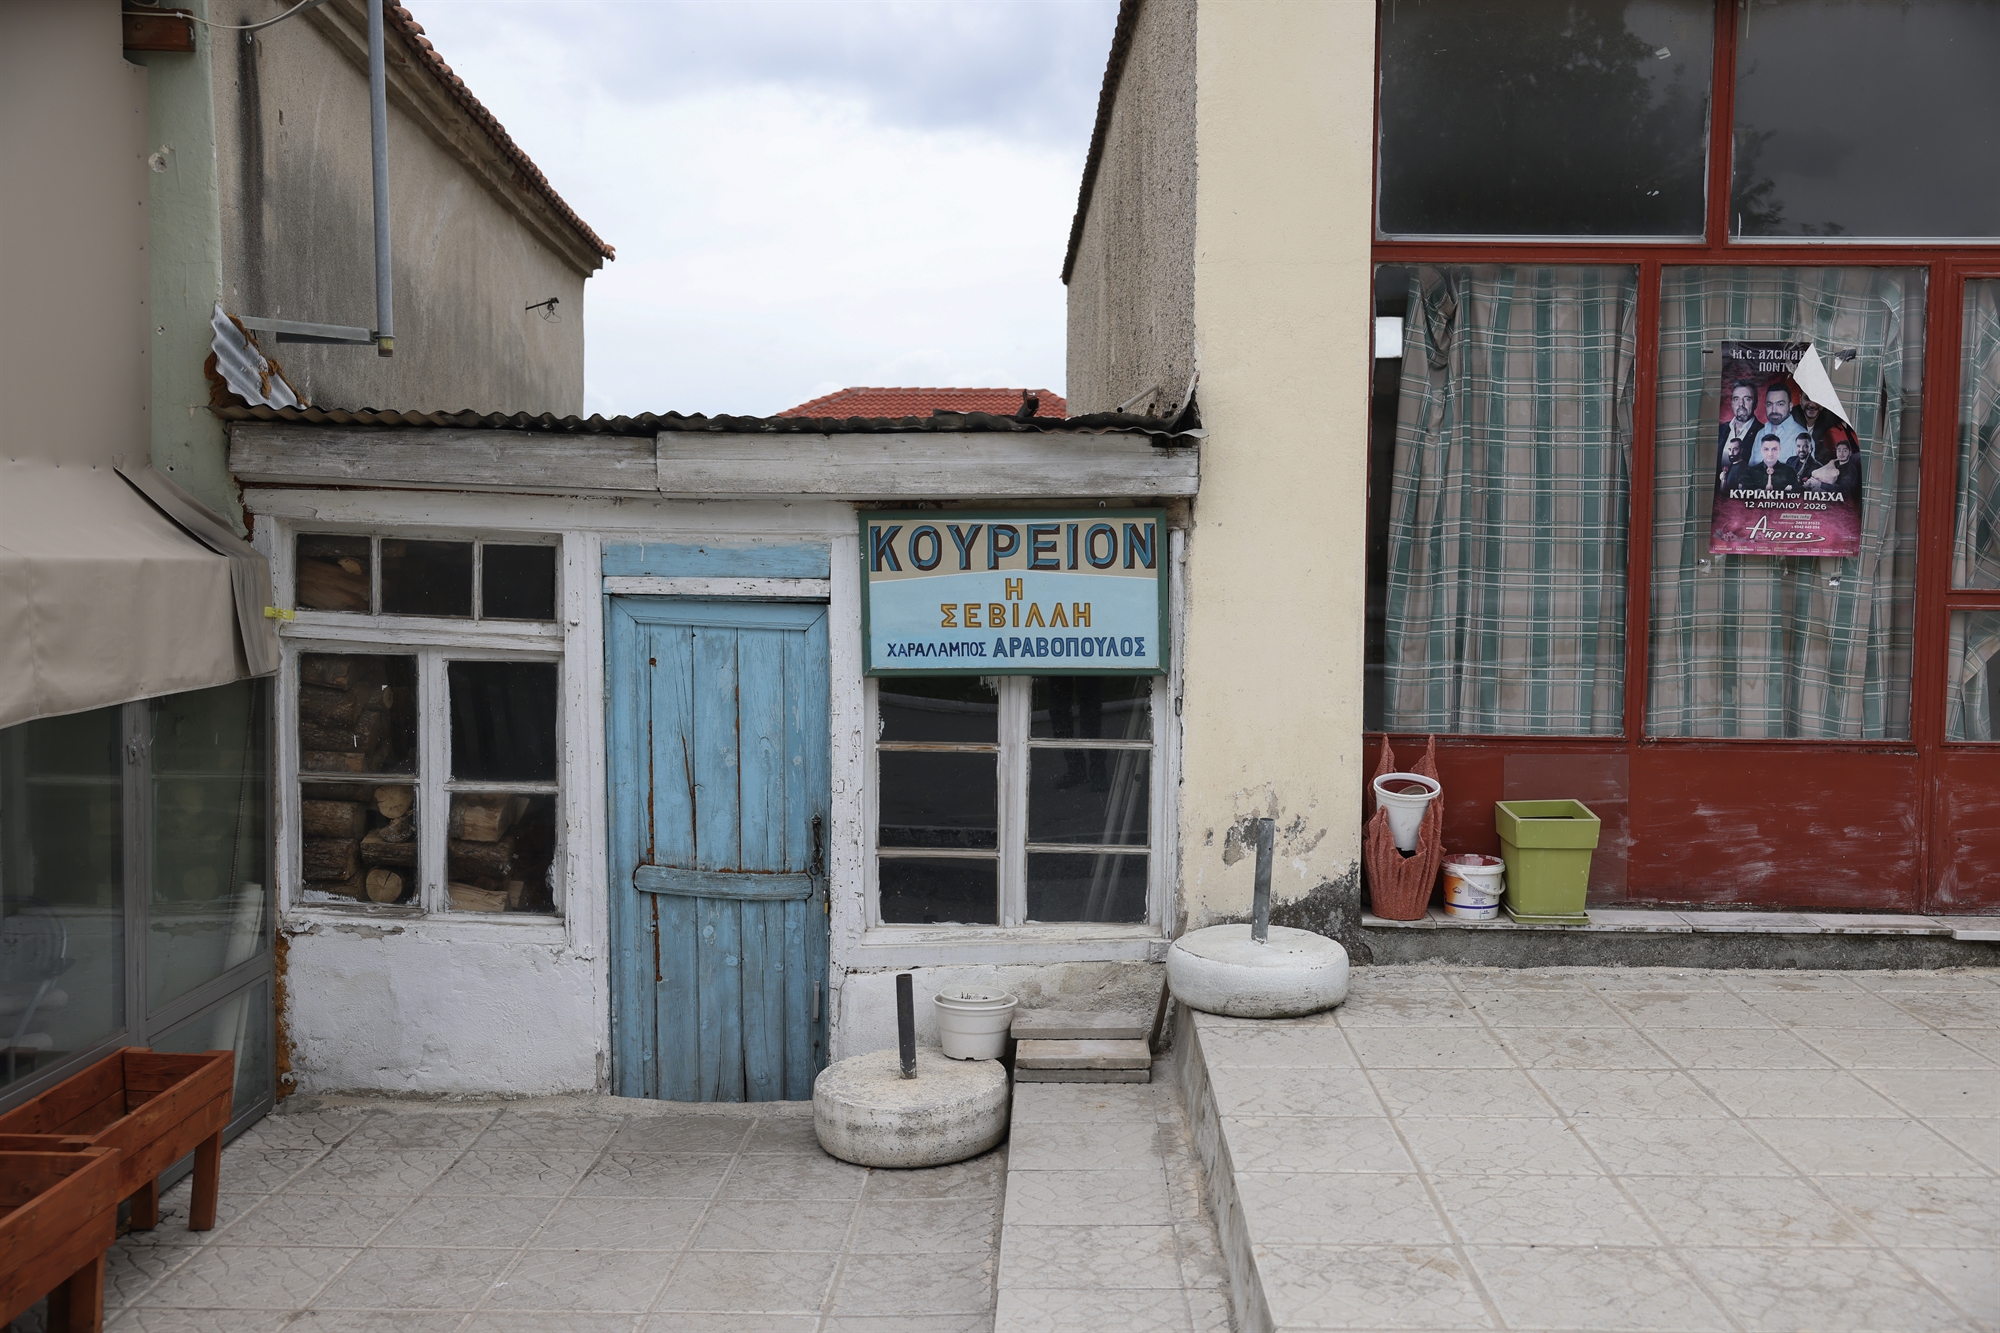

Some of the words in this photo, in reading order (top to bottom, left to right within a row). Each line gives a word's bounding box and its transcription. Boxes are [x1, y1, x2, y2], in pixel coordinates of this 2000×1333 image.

[1729, 489, 1784, 500] ΚΥΡΙΑΚΗ
[1803, 491, 1844, 502] ΠΑΣΧΑ
[1757, 502, 1801, 510] ΑΠΡΙΛΙΟΥ
[870, 523, 1156, 571] ΚΟΥΡΕΙΟΝ
[1005, 578, 1023, 600] Η
[941, 602, 1091, 628] ΣΕΒΙΛΛΗ
[887, 642, 987, 658] ΧΑΡΑΛΑΜΠΟΣ
[993, 636, 1146, 658] ΑΡΑΒΟΠΟΥΛΟΣ
